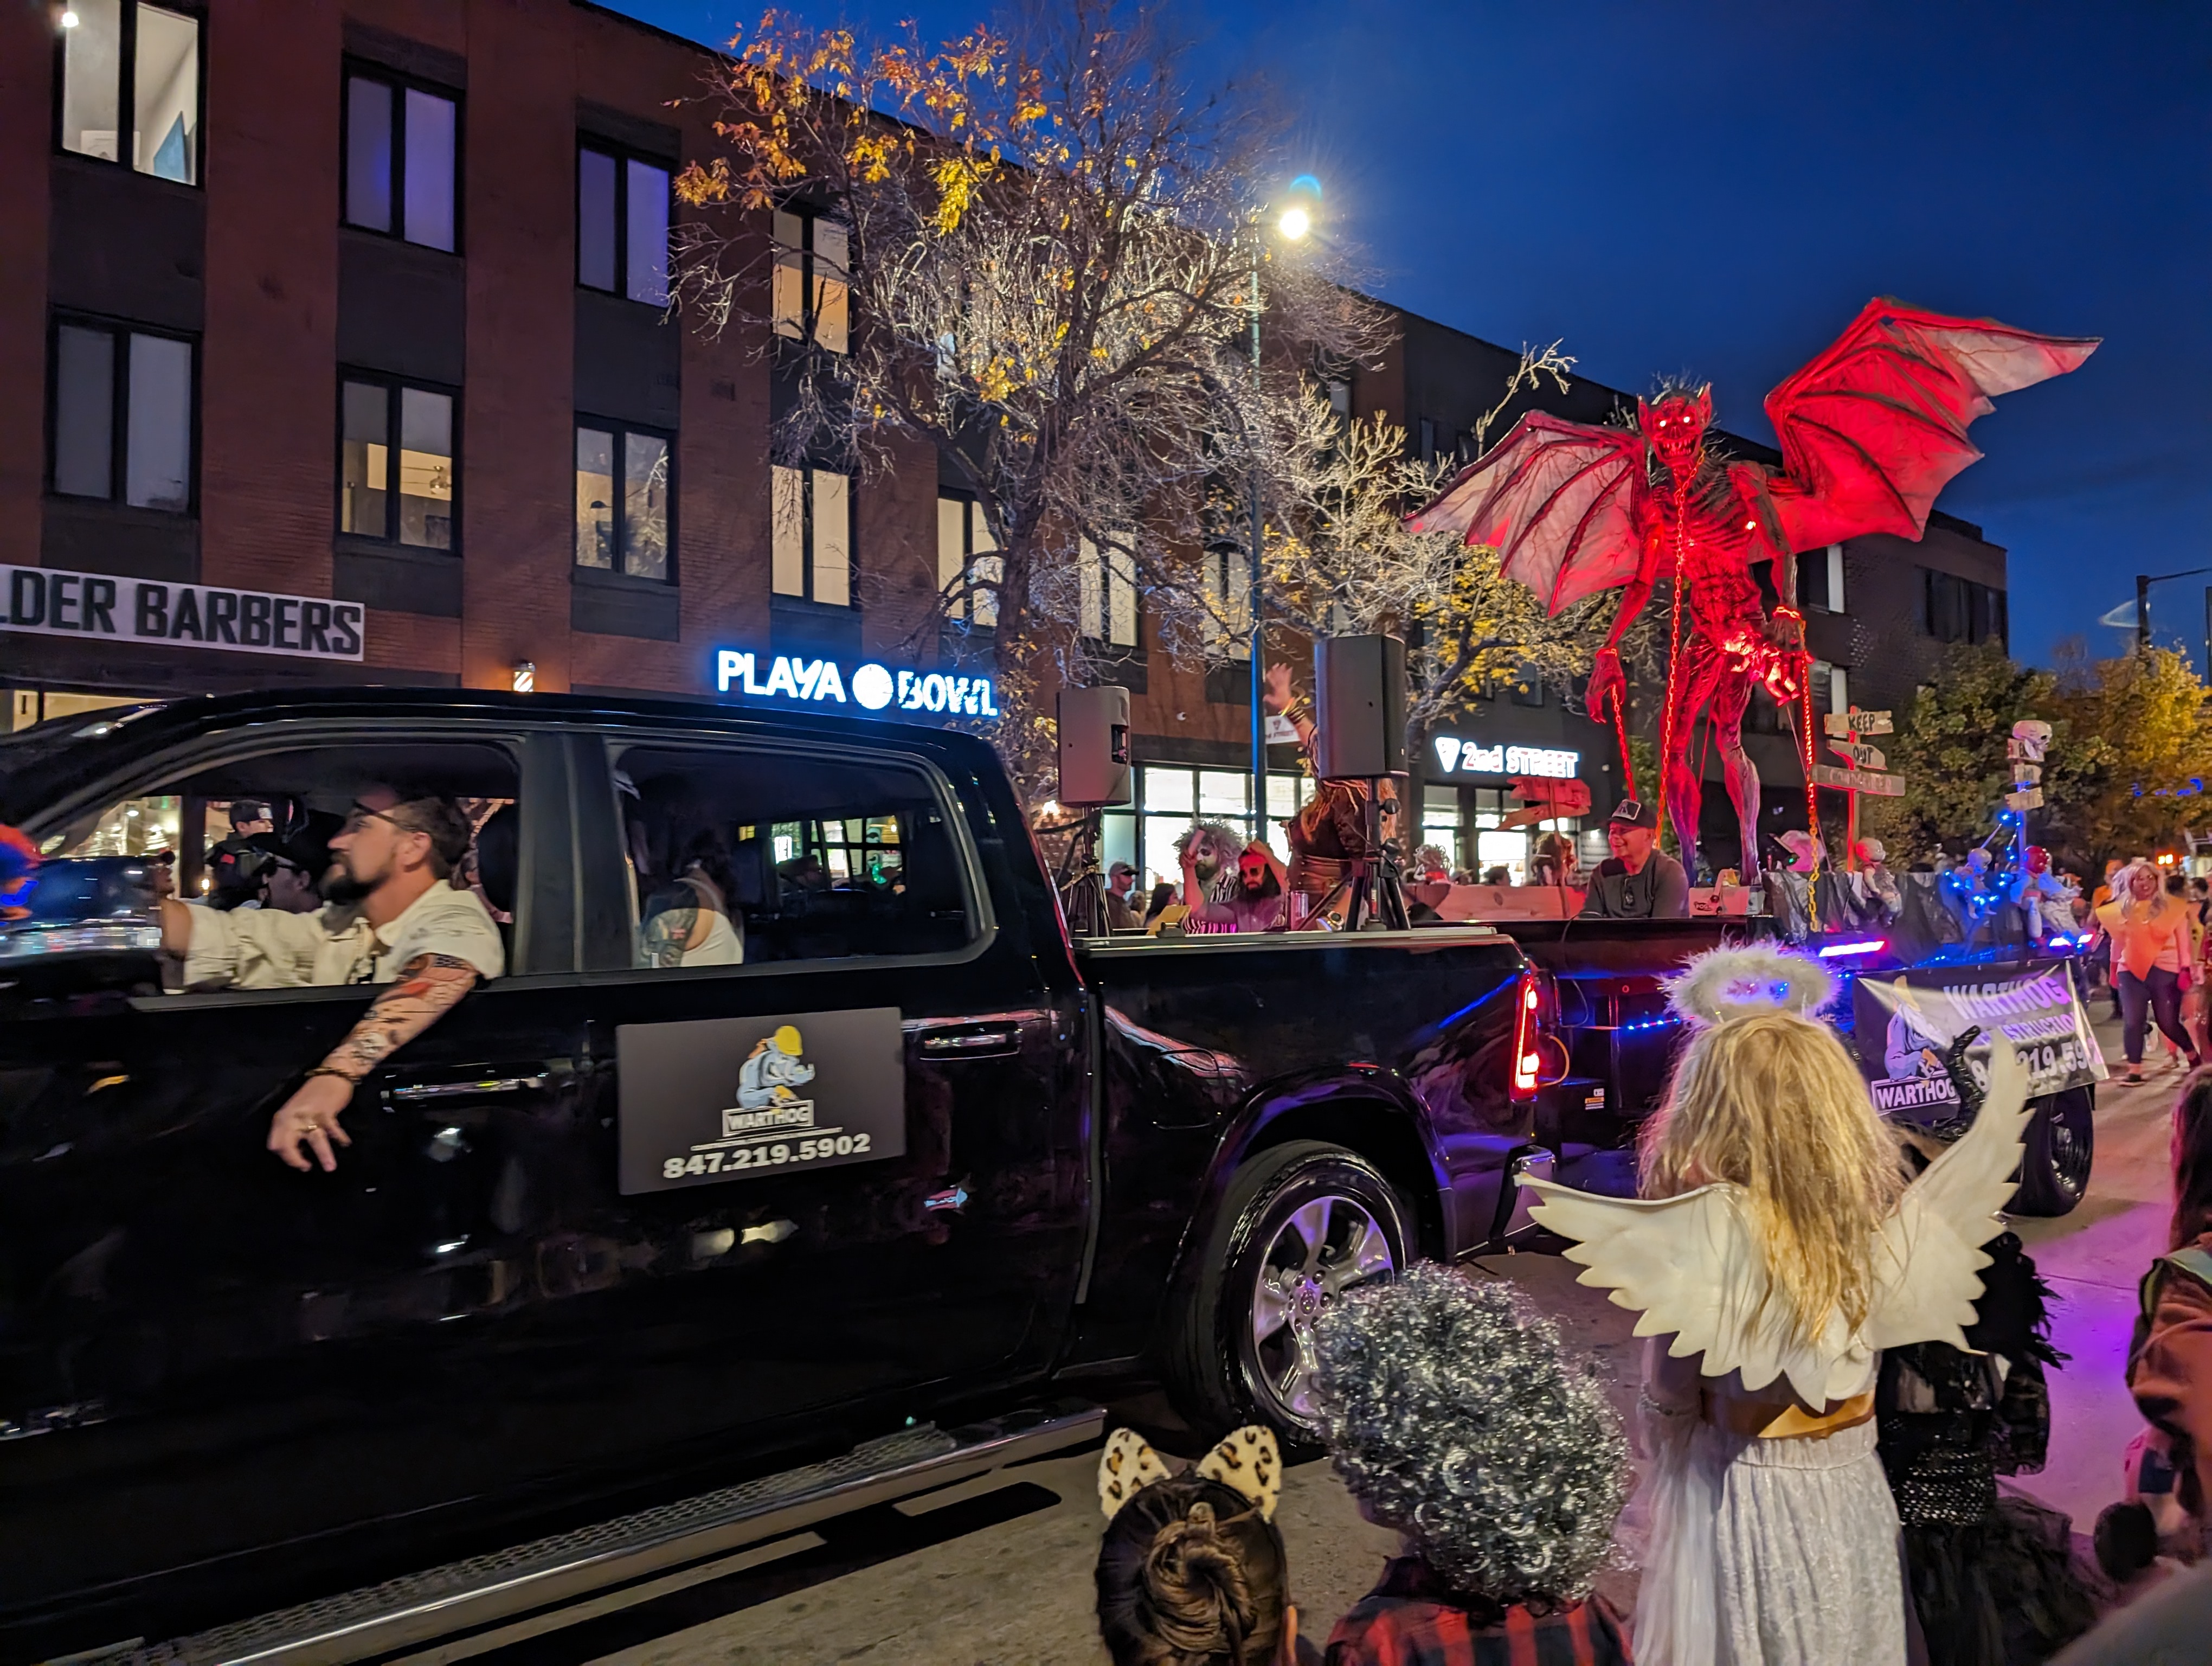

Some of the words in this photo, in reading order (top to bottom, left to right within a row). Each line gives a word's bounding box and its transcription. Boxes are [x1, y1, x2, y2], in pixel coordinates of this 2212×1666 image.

[0, 569, 115, 633] DER
[135, 583, 361, 655] BARBERS
[718, 650, 846, 703] PLAYA
[1848, 713, 1875, 732] KEEP
[1462, 741, 1503, 772] 2nd
[1506, 746, 1579, 778] STREET
[1853, 745, 1874, 764] OUT
[1943, 976, 2072, 1020] WARTHOG
[1877, 1078, 1956, 1109] WARTHOG
[663, 1133, 871, 1178] 847.219.5902
